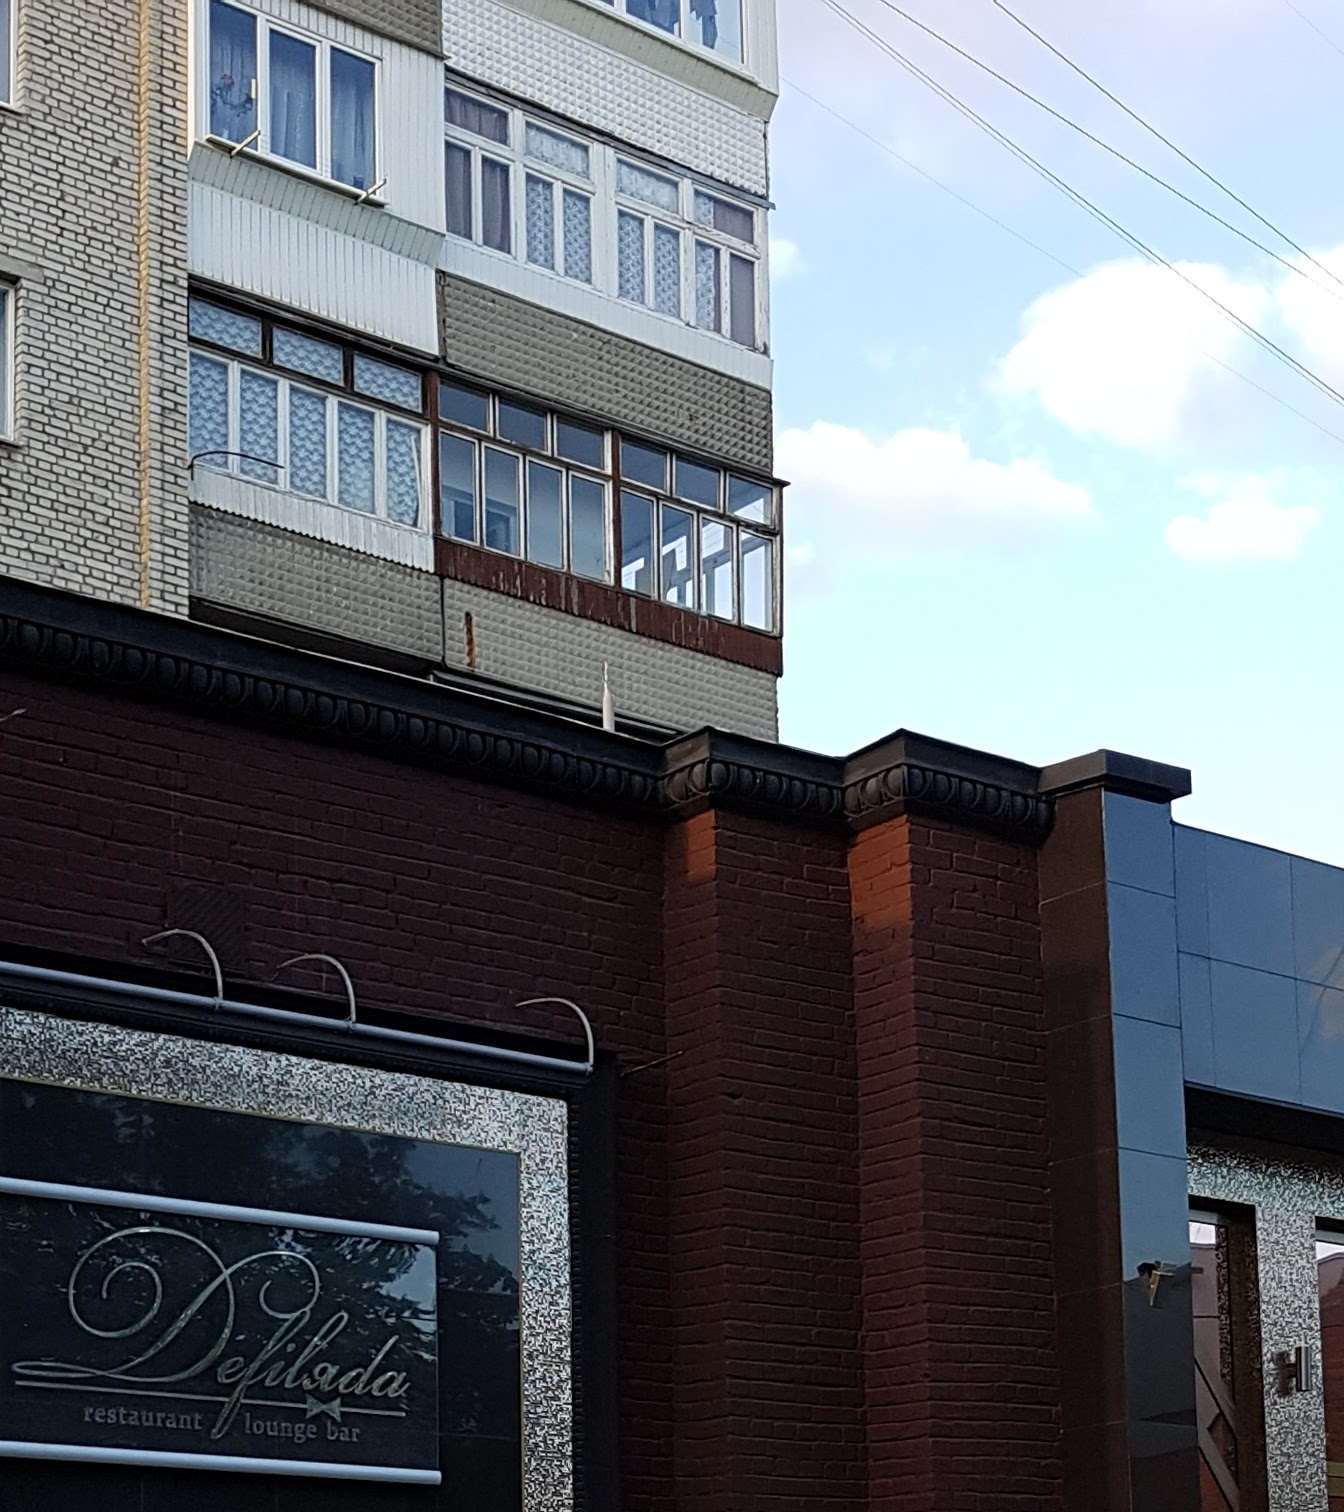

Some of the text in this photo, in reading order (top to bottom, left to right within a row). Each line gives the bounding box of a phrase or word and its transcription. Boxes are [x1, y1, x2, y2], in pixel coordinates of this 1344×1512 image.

[83, 1404, 360, 1443] restaurant lounge bar
